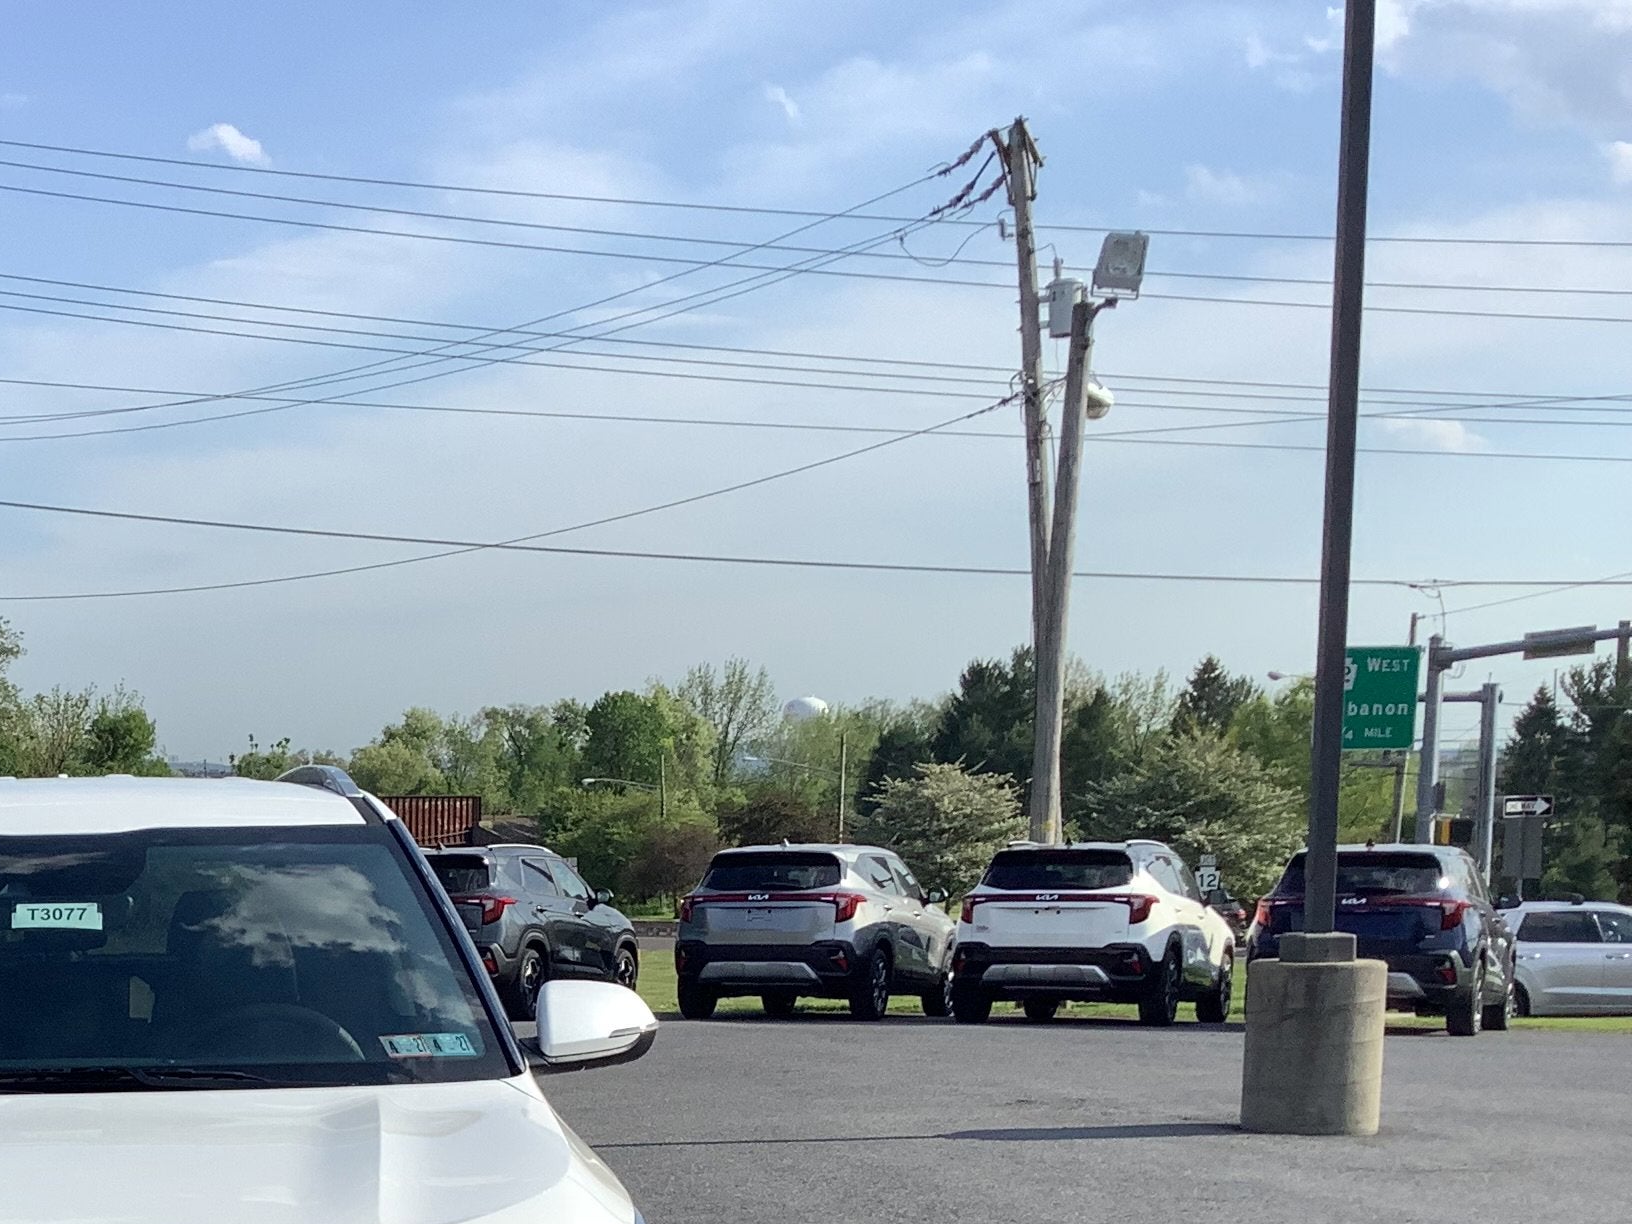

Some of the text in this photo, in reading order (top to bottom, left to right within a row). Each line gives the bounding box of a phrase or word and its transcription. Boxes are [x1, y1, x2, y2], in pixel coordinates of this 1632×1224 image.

[1367, 657, 1410, 672] WEST
[1347, 701, 1409, 716] banon
[1364, 726, 1394, 739] MILE
[1198, 873, 1217, 888] 12
[26, 907, 88, 921] T3077
